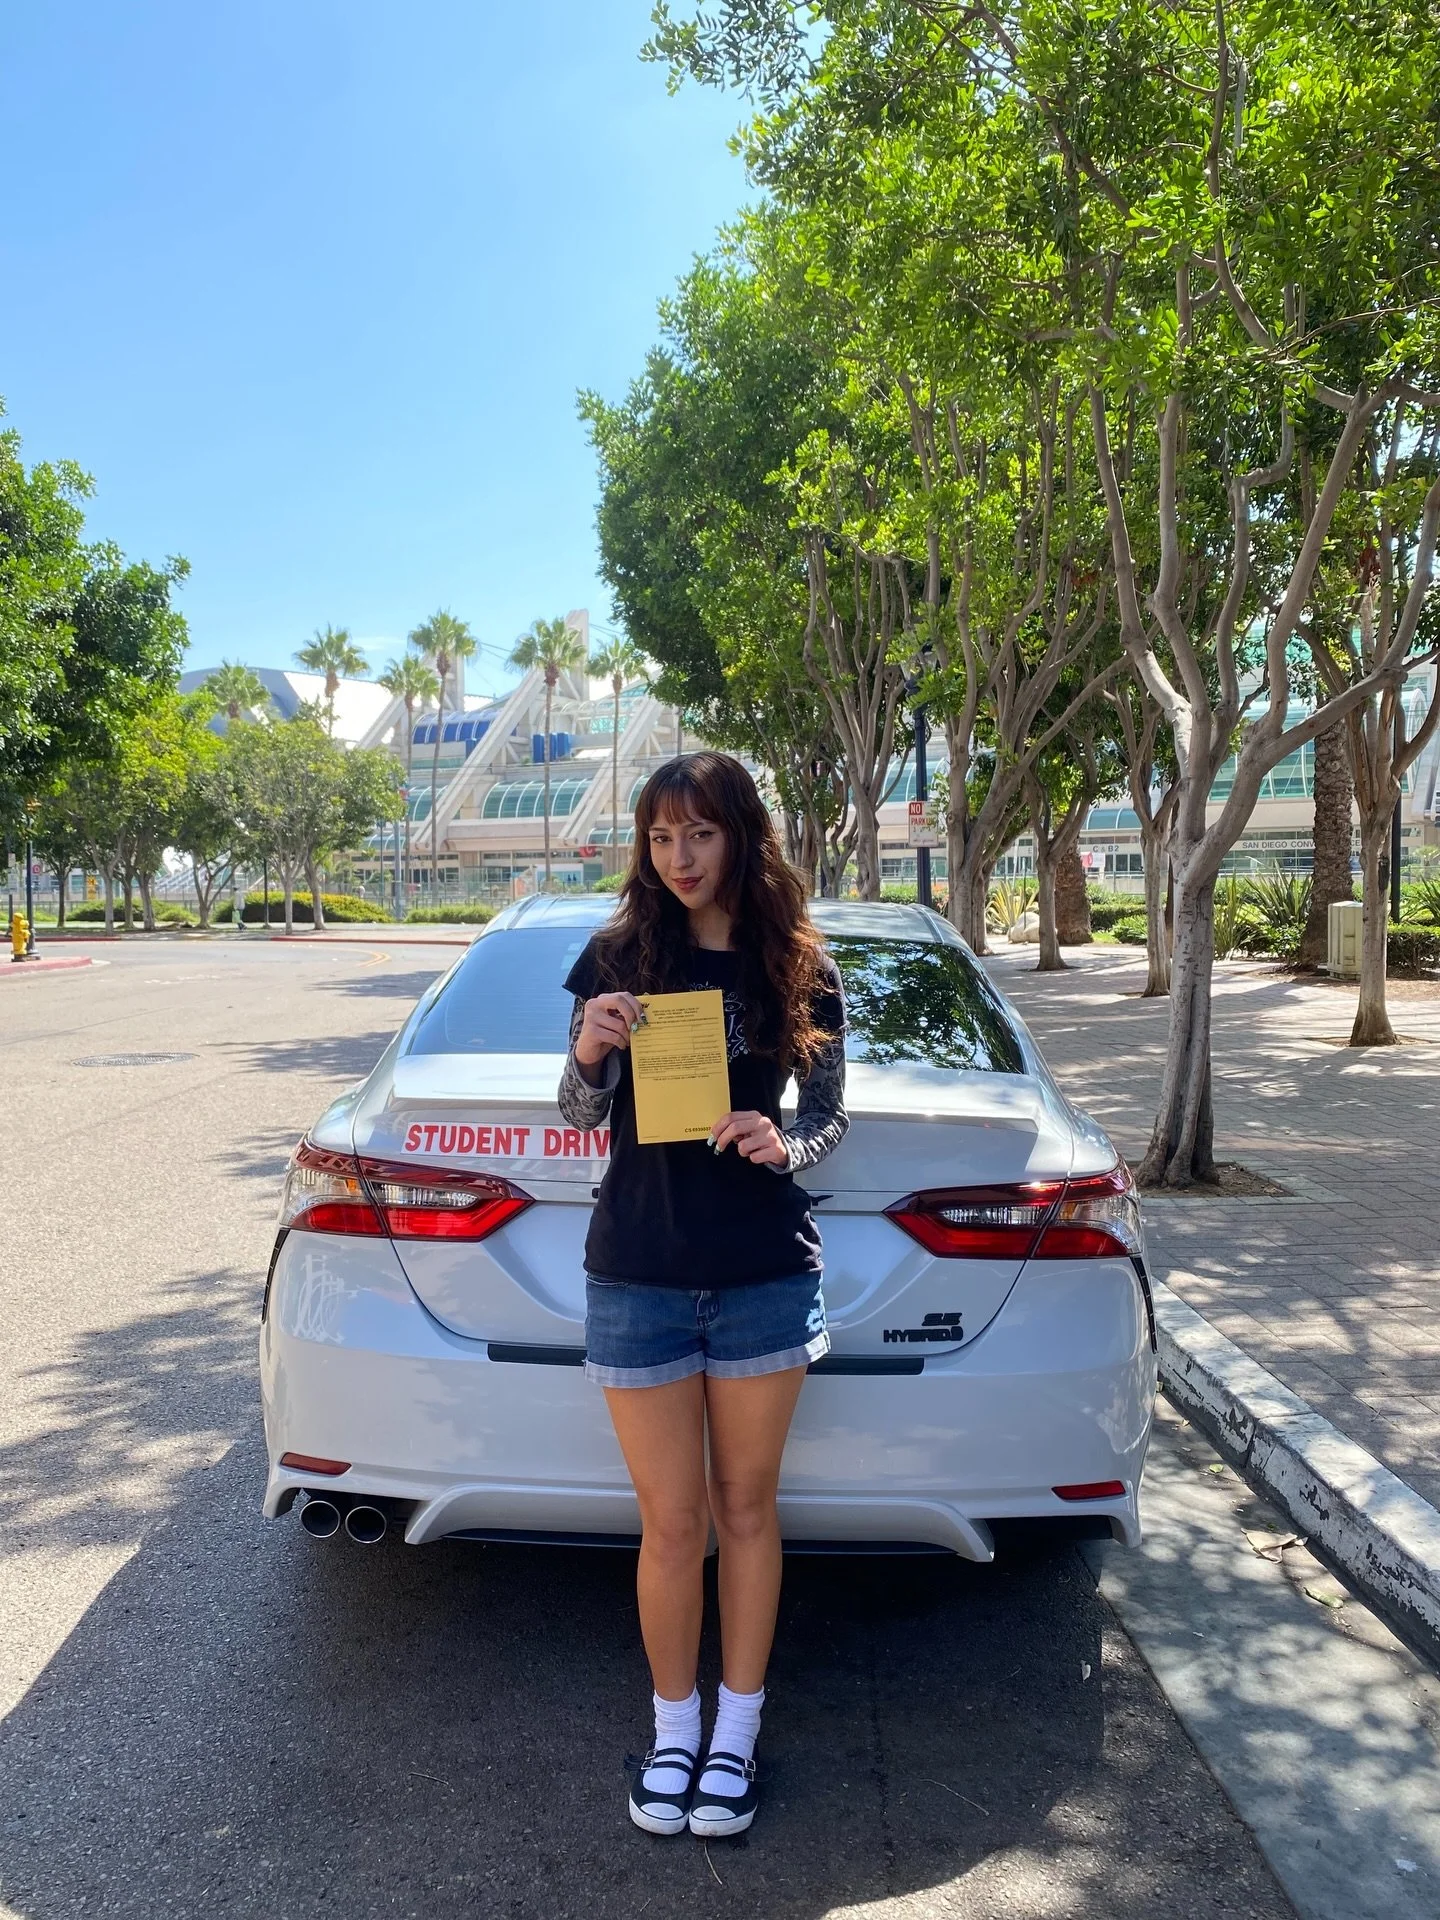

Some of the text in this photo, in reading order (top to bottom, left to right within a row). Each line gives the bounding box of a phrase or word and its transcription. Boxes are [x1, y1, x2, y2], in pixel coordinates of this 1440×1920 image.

[910, 803, 921, 814] NO
[1242, 841, 1259, 849] SAN
[1262, 841, 1288, 849] DIEGO
[404, 1124, 611, 1157] STUDENT DRIV
